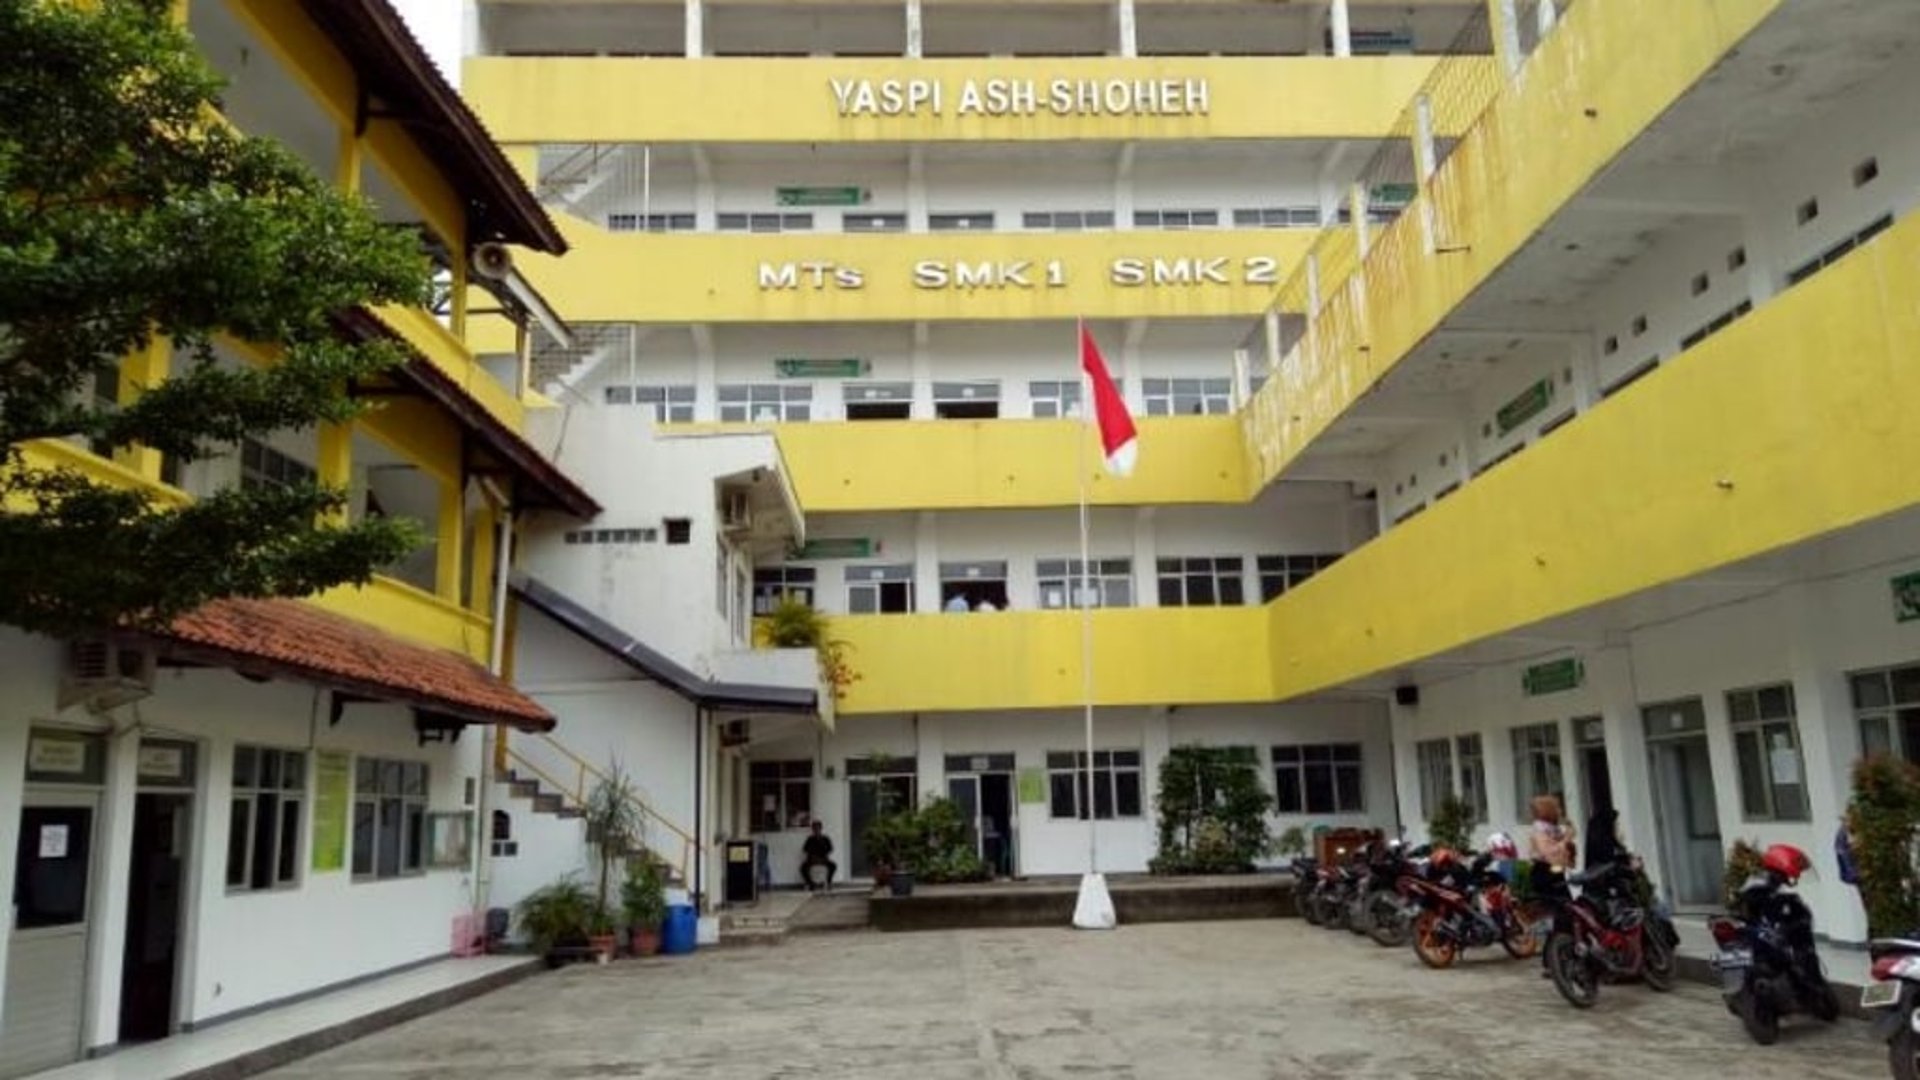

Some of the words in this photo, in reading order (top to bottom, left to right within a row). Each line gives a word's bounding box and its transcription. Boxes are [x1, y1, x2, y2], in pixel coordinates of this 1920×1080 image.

[831, 79, 942, 117] YASPI
[957, 79, 1211, 117] ASH-SHOHEH
[758, 260, 865, 289] MTs
[913, 258, 1034, 288] SMK
[1047, 260, 1068, 286] 1
[1111, 256, 1229, 284] SMK
[1243, 255, 1278, 284] 2
